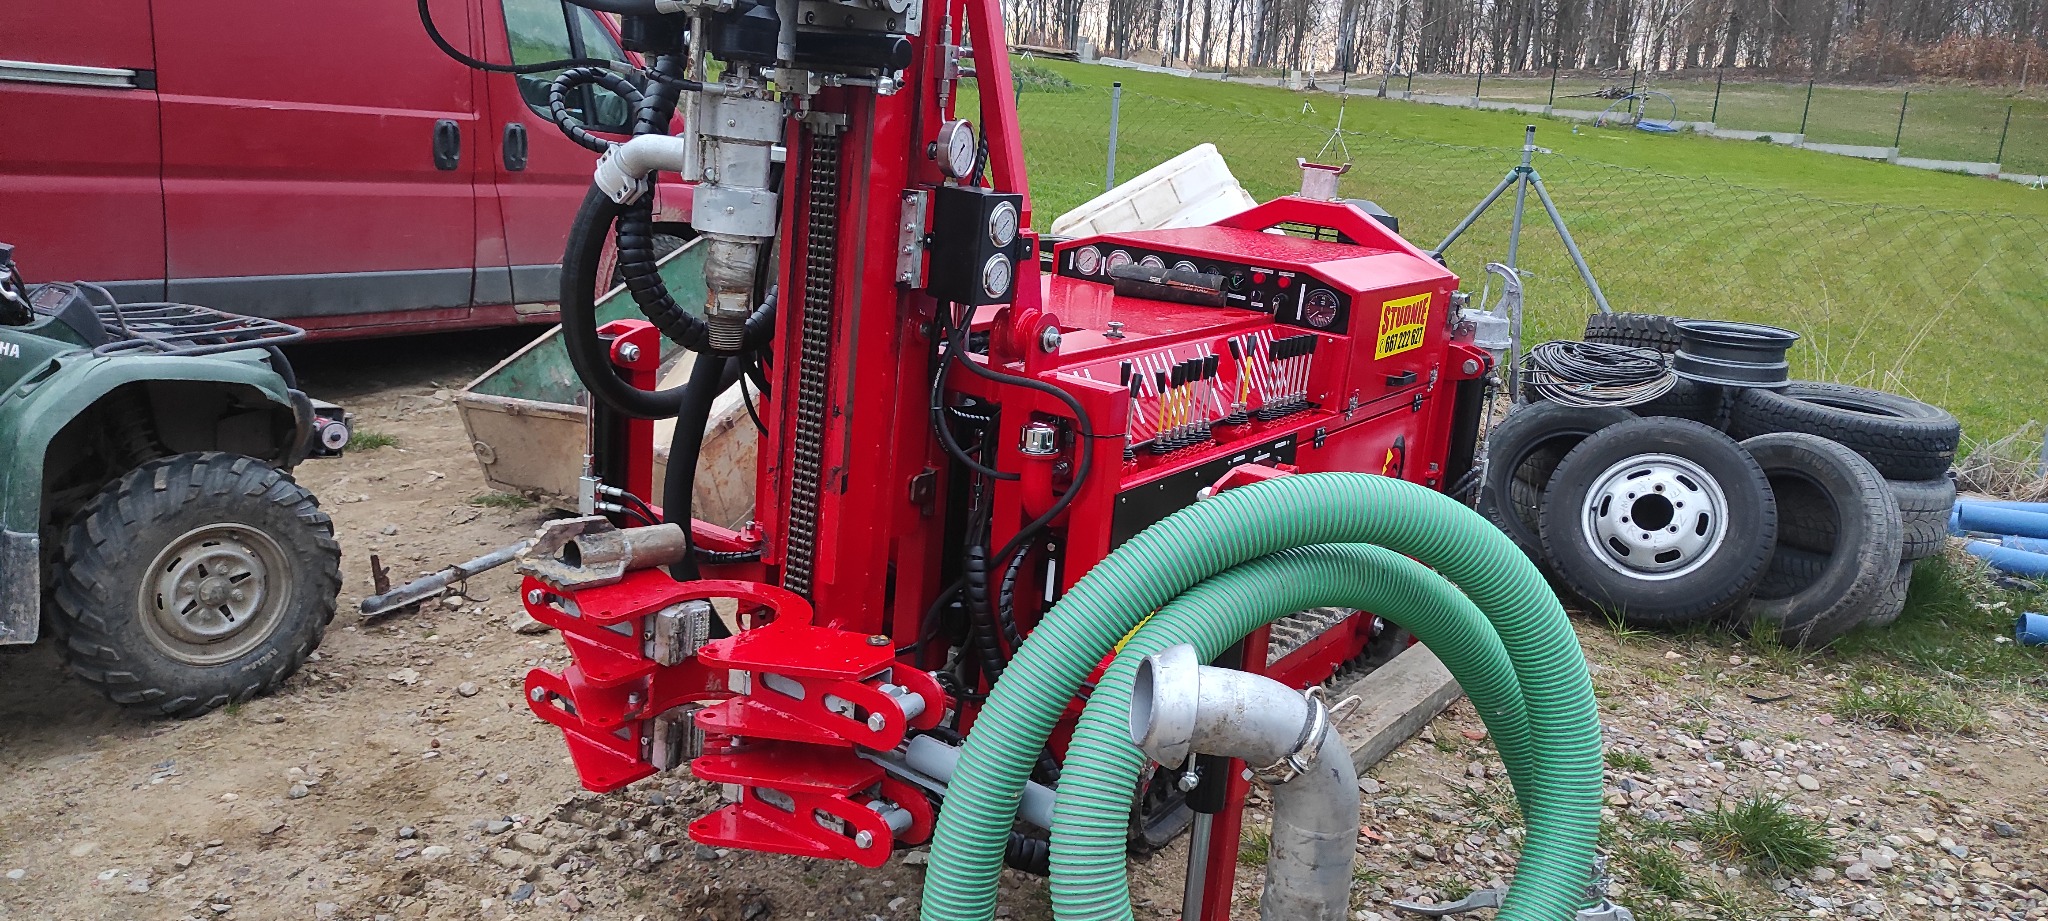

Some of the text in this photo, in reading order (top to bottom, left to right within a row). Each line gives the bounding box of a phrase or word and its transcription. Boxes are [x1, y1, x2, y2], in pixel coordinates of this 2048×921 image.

[1381, 296, 1429, 335] STUDNIE
[1384, 326, 1424, 353] 667 222 627
